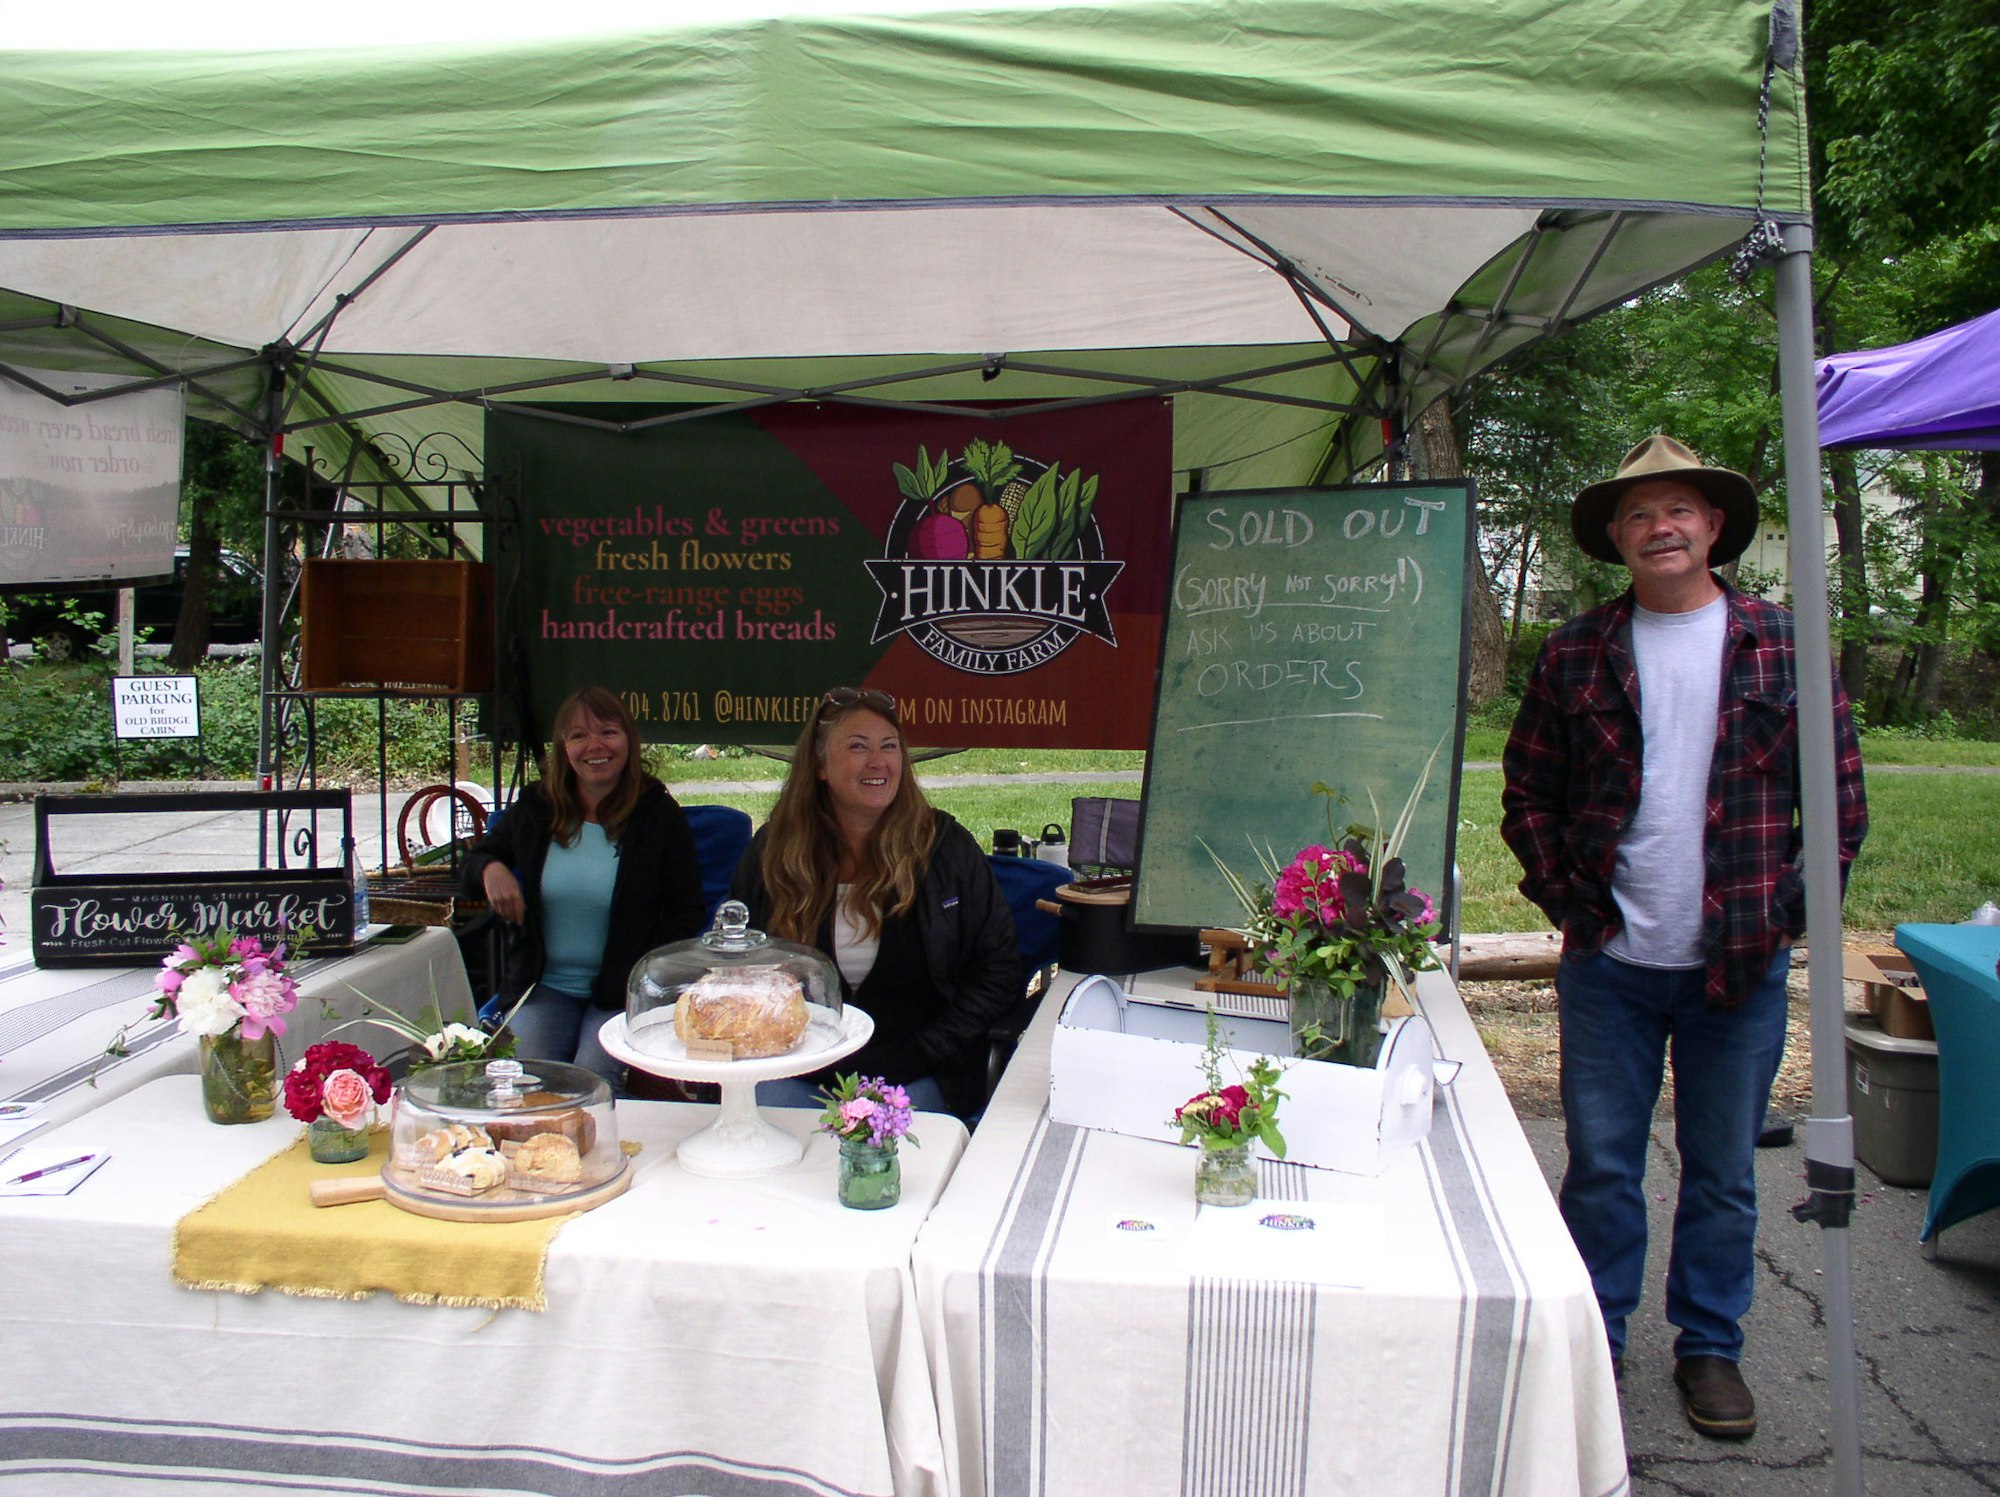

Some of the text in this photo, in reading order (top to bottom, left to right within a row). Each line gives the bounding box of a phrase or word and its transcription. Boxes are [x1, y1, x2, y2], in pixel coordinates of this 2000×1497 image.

[539, 505, 841, 547] vegetables & greens
[1206, 496, 1446, 550] SOLD OUT
[595, 539, 793, 571] fresh flowers
[573, 575, 805, 617] free-range eggs
[900, 565, 1087, 622] HINKLE
[540, 609, 837, 641] handcrafted breads
[1186, 621, 1378, 656] ASK US ABOUT
[919, 629, 1068, 672] FAMILY FARM
[130, 680, 181, 692] GUEST
[1197, 659, 1364, 701] ORDERS
[121, 693, 192, 705] PARKING
[149, 706, 165, 715] for
[924, 697, 952, 725] ON
[960, 697, 1068, 727] INSTAGRAM
[125, 716, 191, 726] OLD BRIDGE
[140, 726, 176, 735] CABIN
[41, 894, 347, 939] Flower Market
[71, 938, 105, 948] Fresh
[109, 937, 130, 947] Cut
